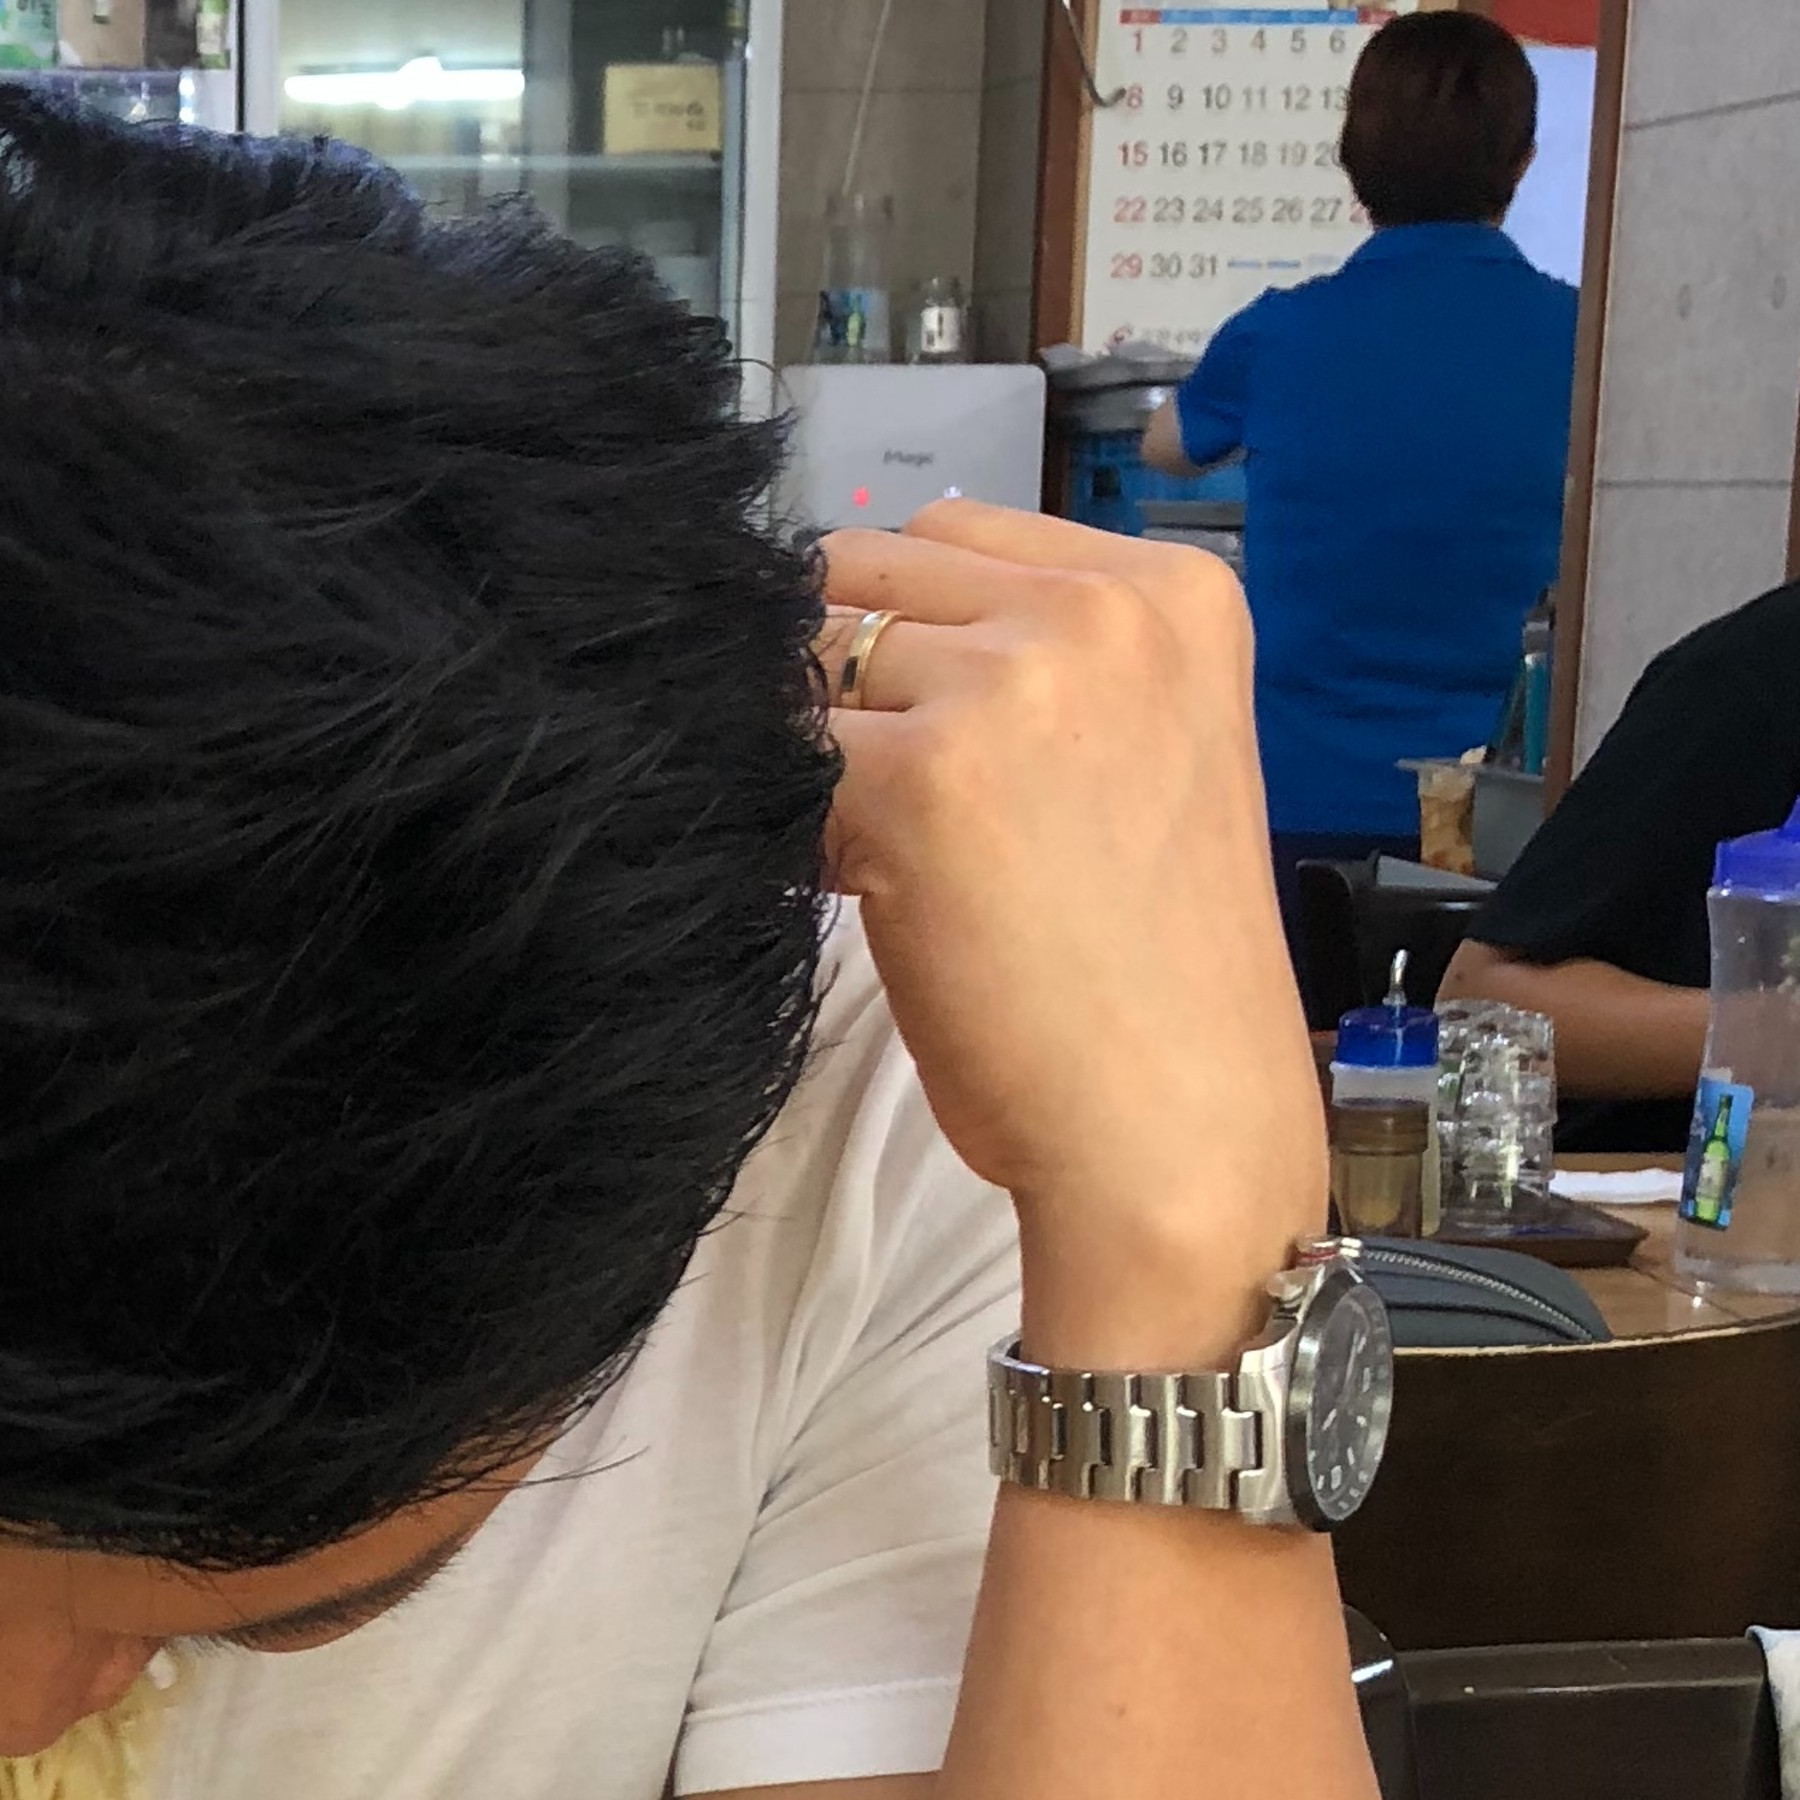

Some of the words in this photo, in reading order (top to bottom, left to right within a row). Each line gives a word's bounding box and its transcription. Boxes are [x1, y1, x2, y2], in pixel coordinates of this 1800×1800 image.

[1133, 29, 1143, 53] 1
[1170, 28, 1188, 54] 2
[1211, 28, 1228, 54] 3
[1250, 28, 1267, 53] 4
[1290, 28, 1307, 54] 5
[1328, 28, 1346, 54] 6
[1124, 84, 1144, 110] 8
[1167, 84, 1185, 112] 9
[1202, 83, 1232, 112] 10
[1242, 87, 1266, 110] 11
[1282, 85, 1311, 111] 12
[1118, 140, 1148, 168] 15
[1159, 141, 1188, 168] 16
[1198, 140, 1227, 167] 17
[1239, 141, 1267, 167] 18
[1279, 141, 1308, 167] 19
[1113, 196, 1147, 224] 22
[1153, 196, 1185, 224] 23
[1192, 197, 1224, 224] 24
[1231, 197, 1265, 225] 25
[1271, 197, 1303, 224] 26
[1310, 197, 1343, 224] 27
[1349, 200, 1368, 224] 2
[1110, 252, 1143, 279] 29
[1150, 252, 1183, 280] 30
[1189, 253, 1218, 279] 31
